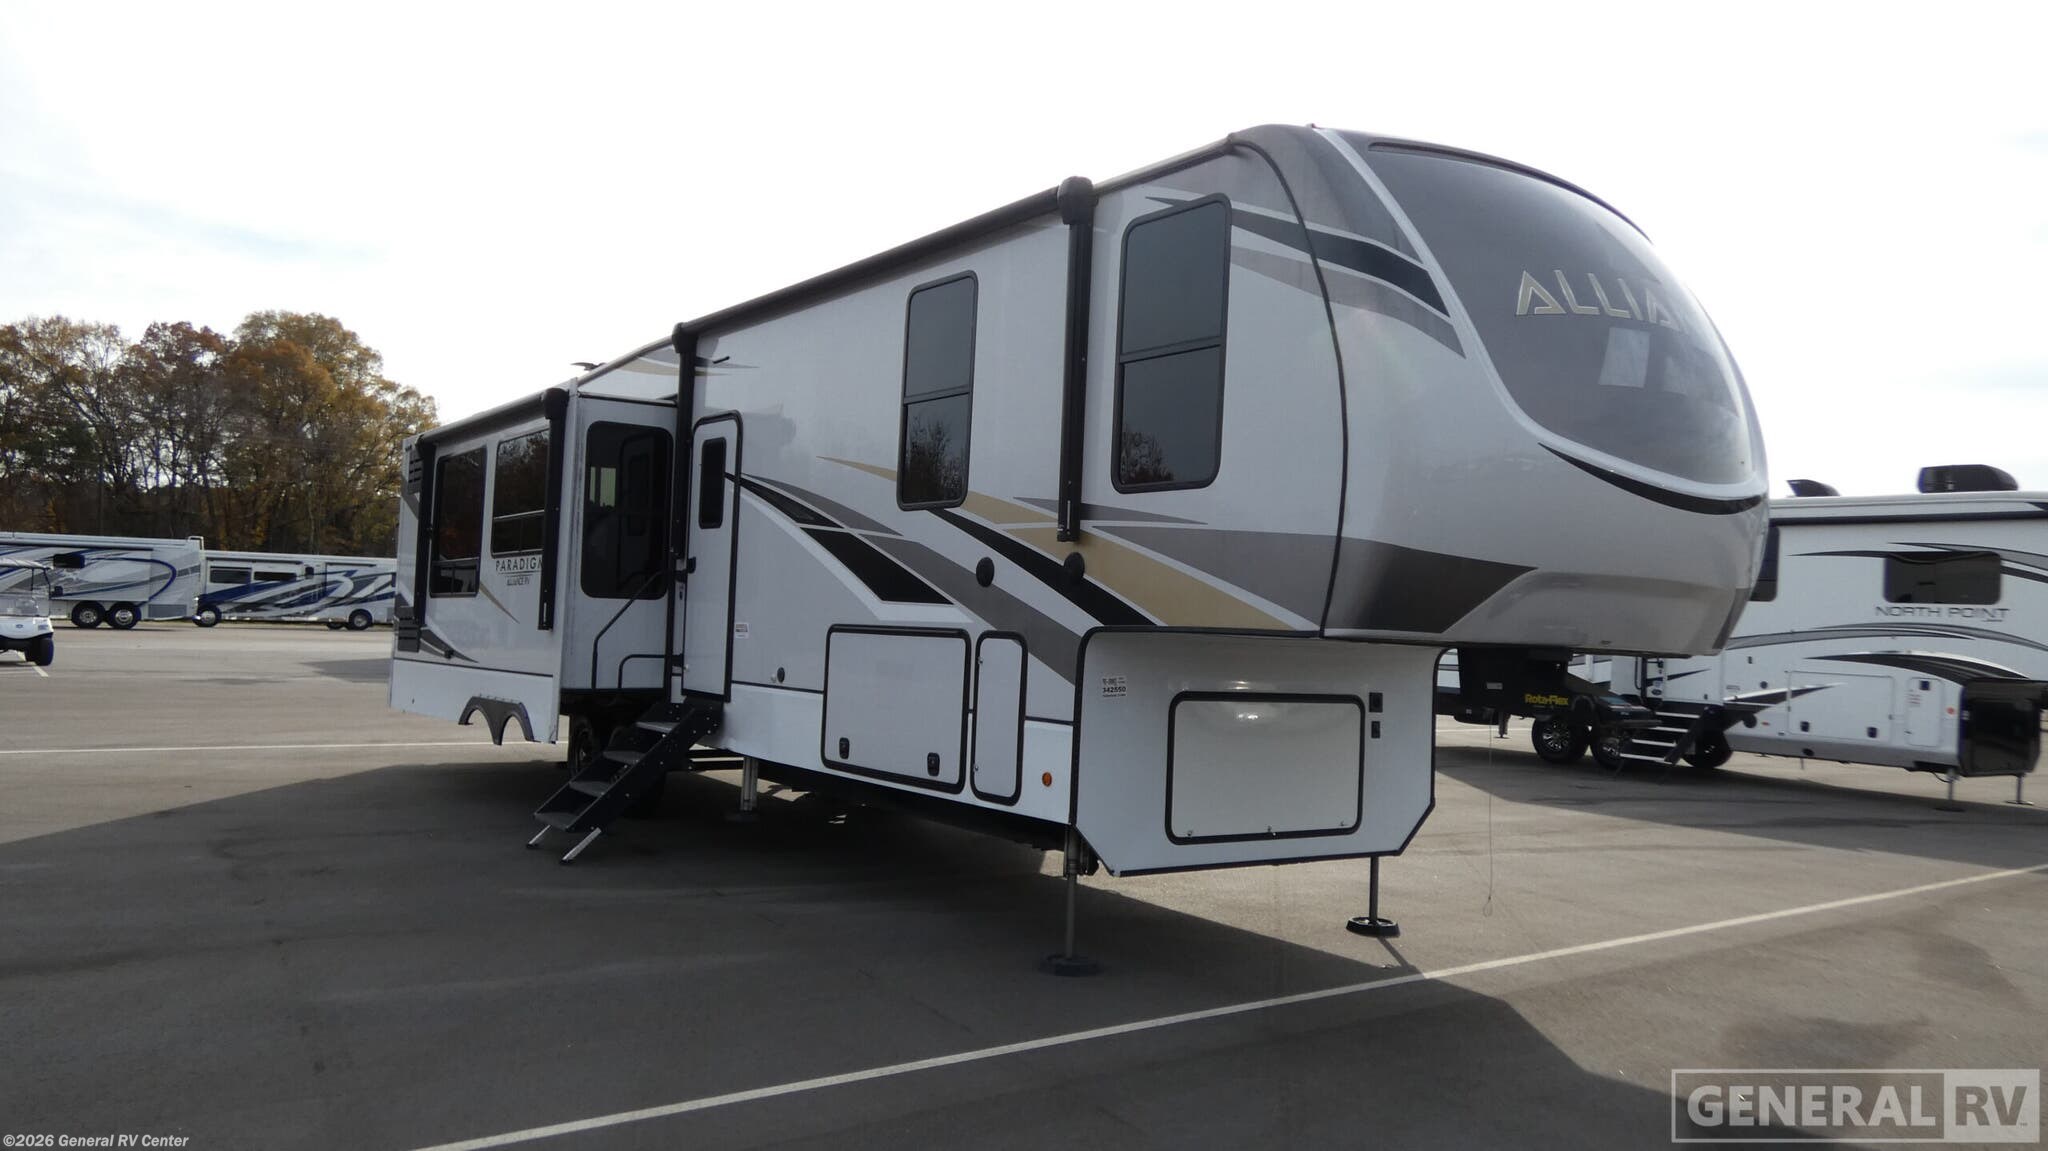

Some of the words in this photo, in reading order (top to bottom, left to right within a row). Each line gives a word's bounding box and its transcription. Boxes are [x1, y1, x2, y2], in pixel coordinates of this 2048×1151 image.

[1515, 269, 1682, 331] ALLIA
[1875, 606, 1942, 617] NORTH
[1948, 607, 2010, 618] POINT
